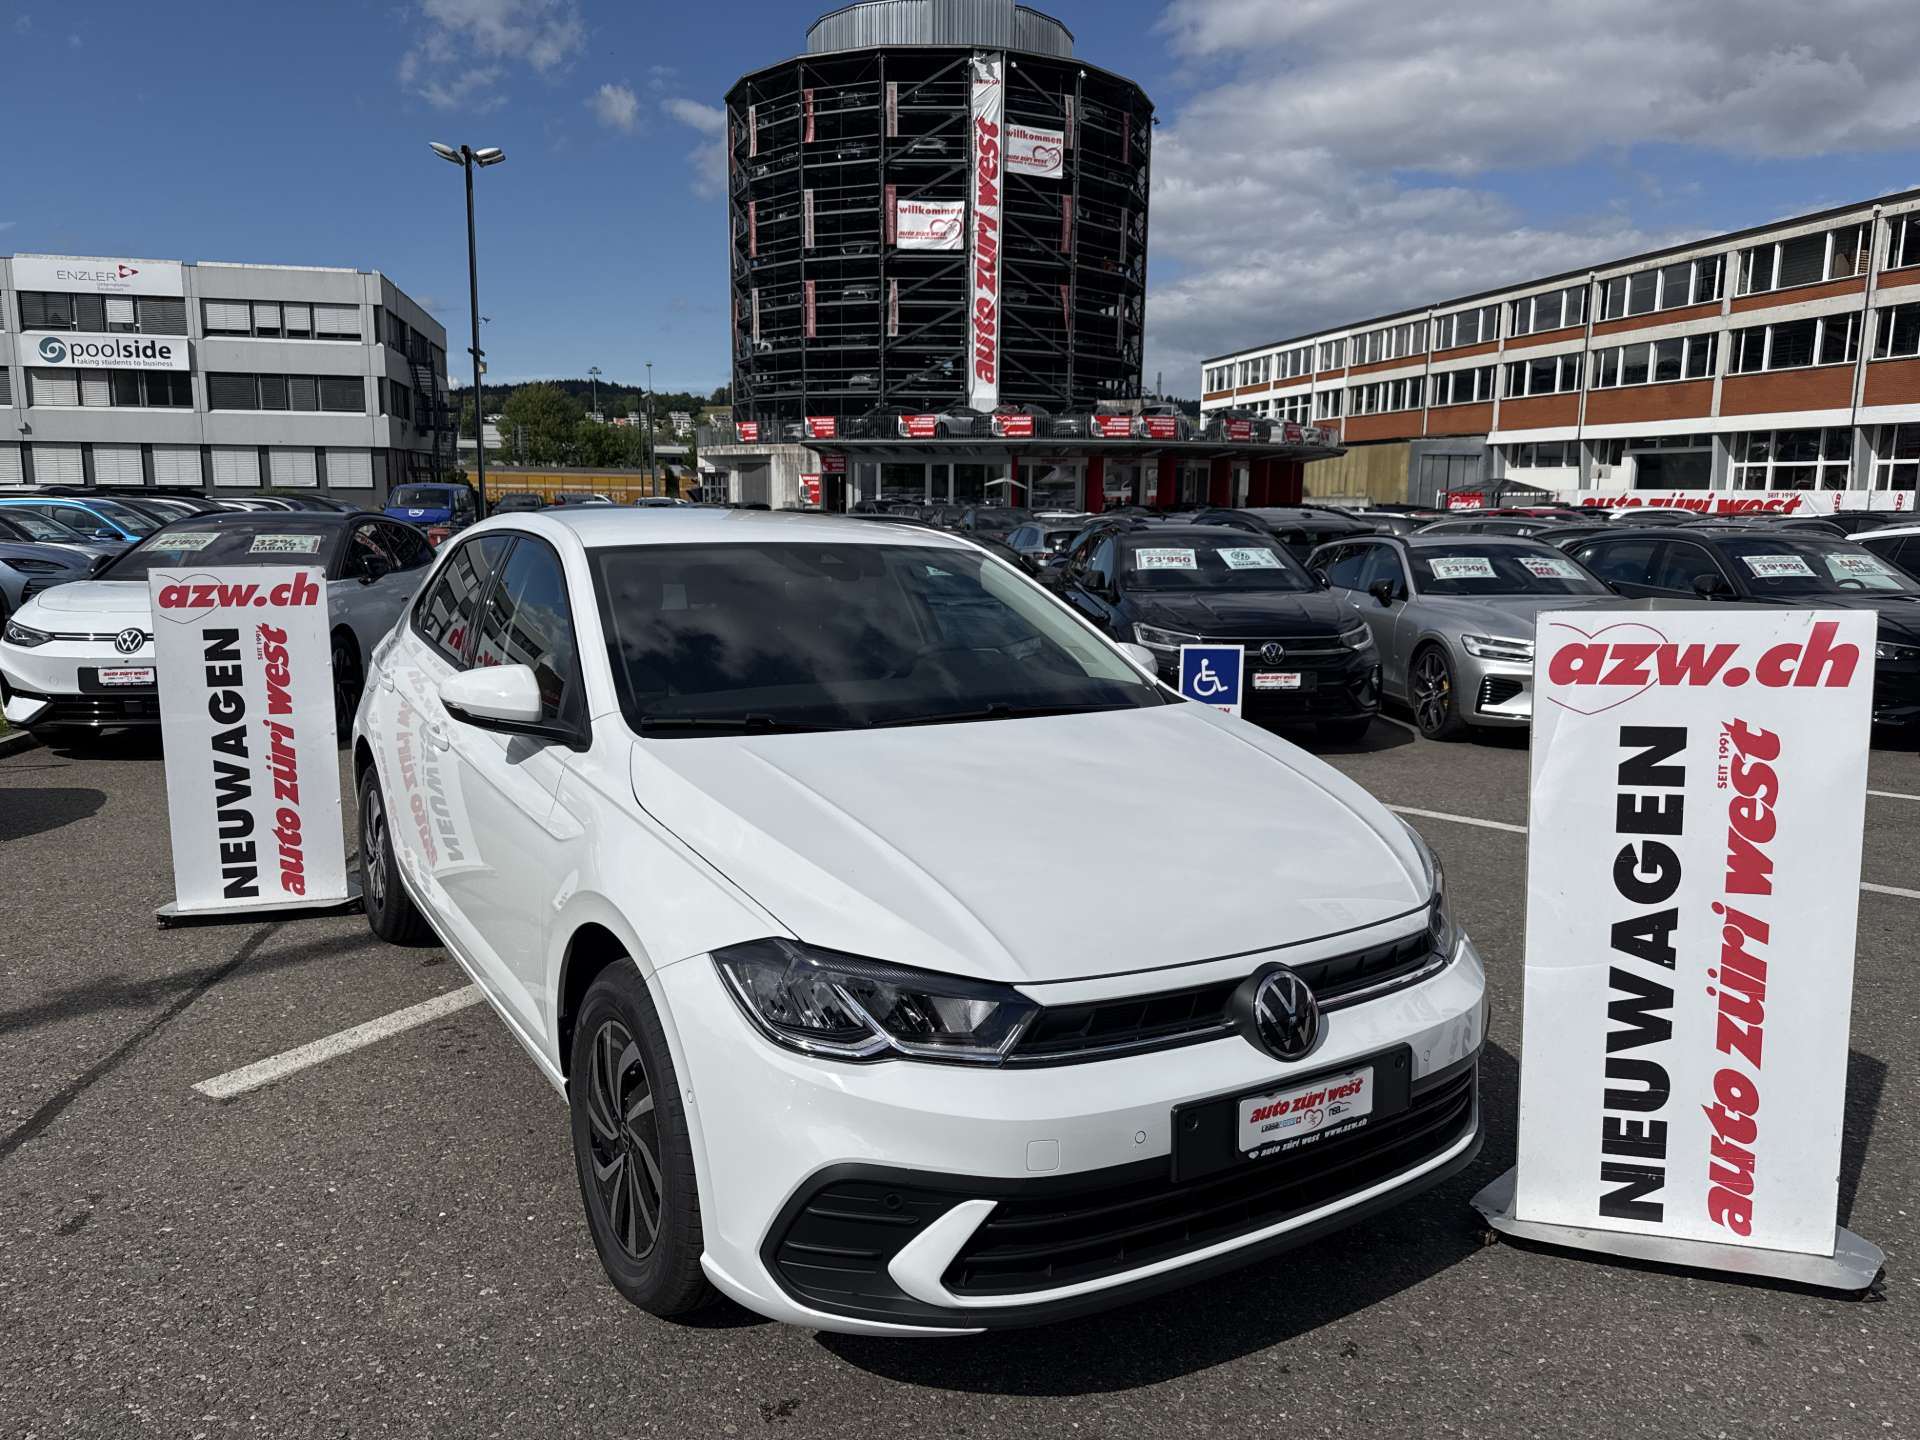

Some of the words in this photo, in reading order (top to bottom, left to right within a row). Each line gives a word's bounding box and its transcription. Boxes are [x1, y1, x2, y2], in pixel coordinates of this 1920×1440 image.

[976, 115, 998, 206] west
[1005, 129, 1062, 144] willkommen
[899, 204, 962, 215] willkommen
[56, 270, 116, 282] ENZLER
[70, 339, 172, 364] poolside
[77, 358, 100, 367] taking
[975, 297, 996, 384] auto
[159, 572, 319, 608] azw.ch
[260, 622, 293, 715] west
[1547, 621, 1860, 688] azw.ch
[202, 628, 259, 899] NEUWAGEN
[263, 719, 300, 806] züri
[1717, 732, 1729, 759] 1991
[1717, 765, 1728, 789] SEIT
[1720, 717, 1782, 896] west
[272, 807, 305, 896] auto
[1599, 725, 1688, 1223] NEUWAGEN
[1706, 901, 1770, 1071] züri
[1250, 1100, 1290, 1123] auto
[1291, 1088, 1328, 1112] züri
[1328, 1078, 1364, 1102] west
[1260, 1145, 1281, 1157] auto
[1701, 1068, 1760, 1238] auto
